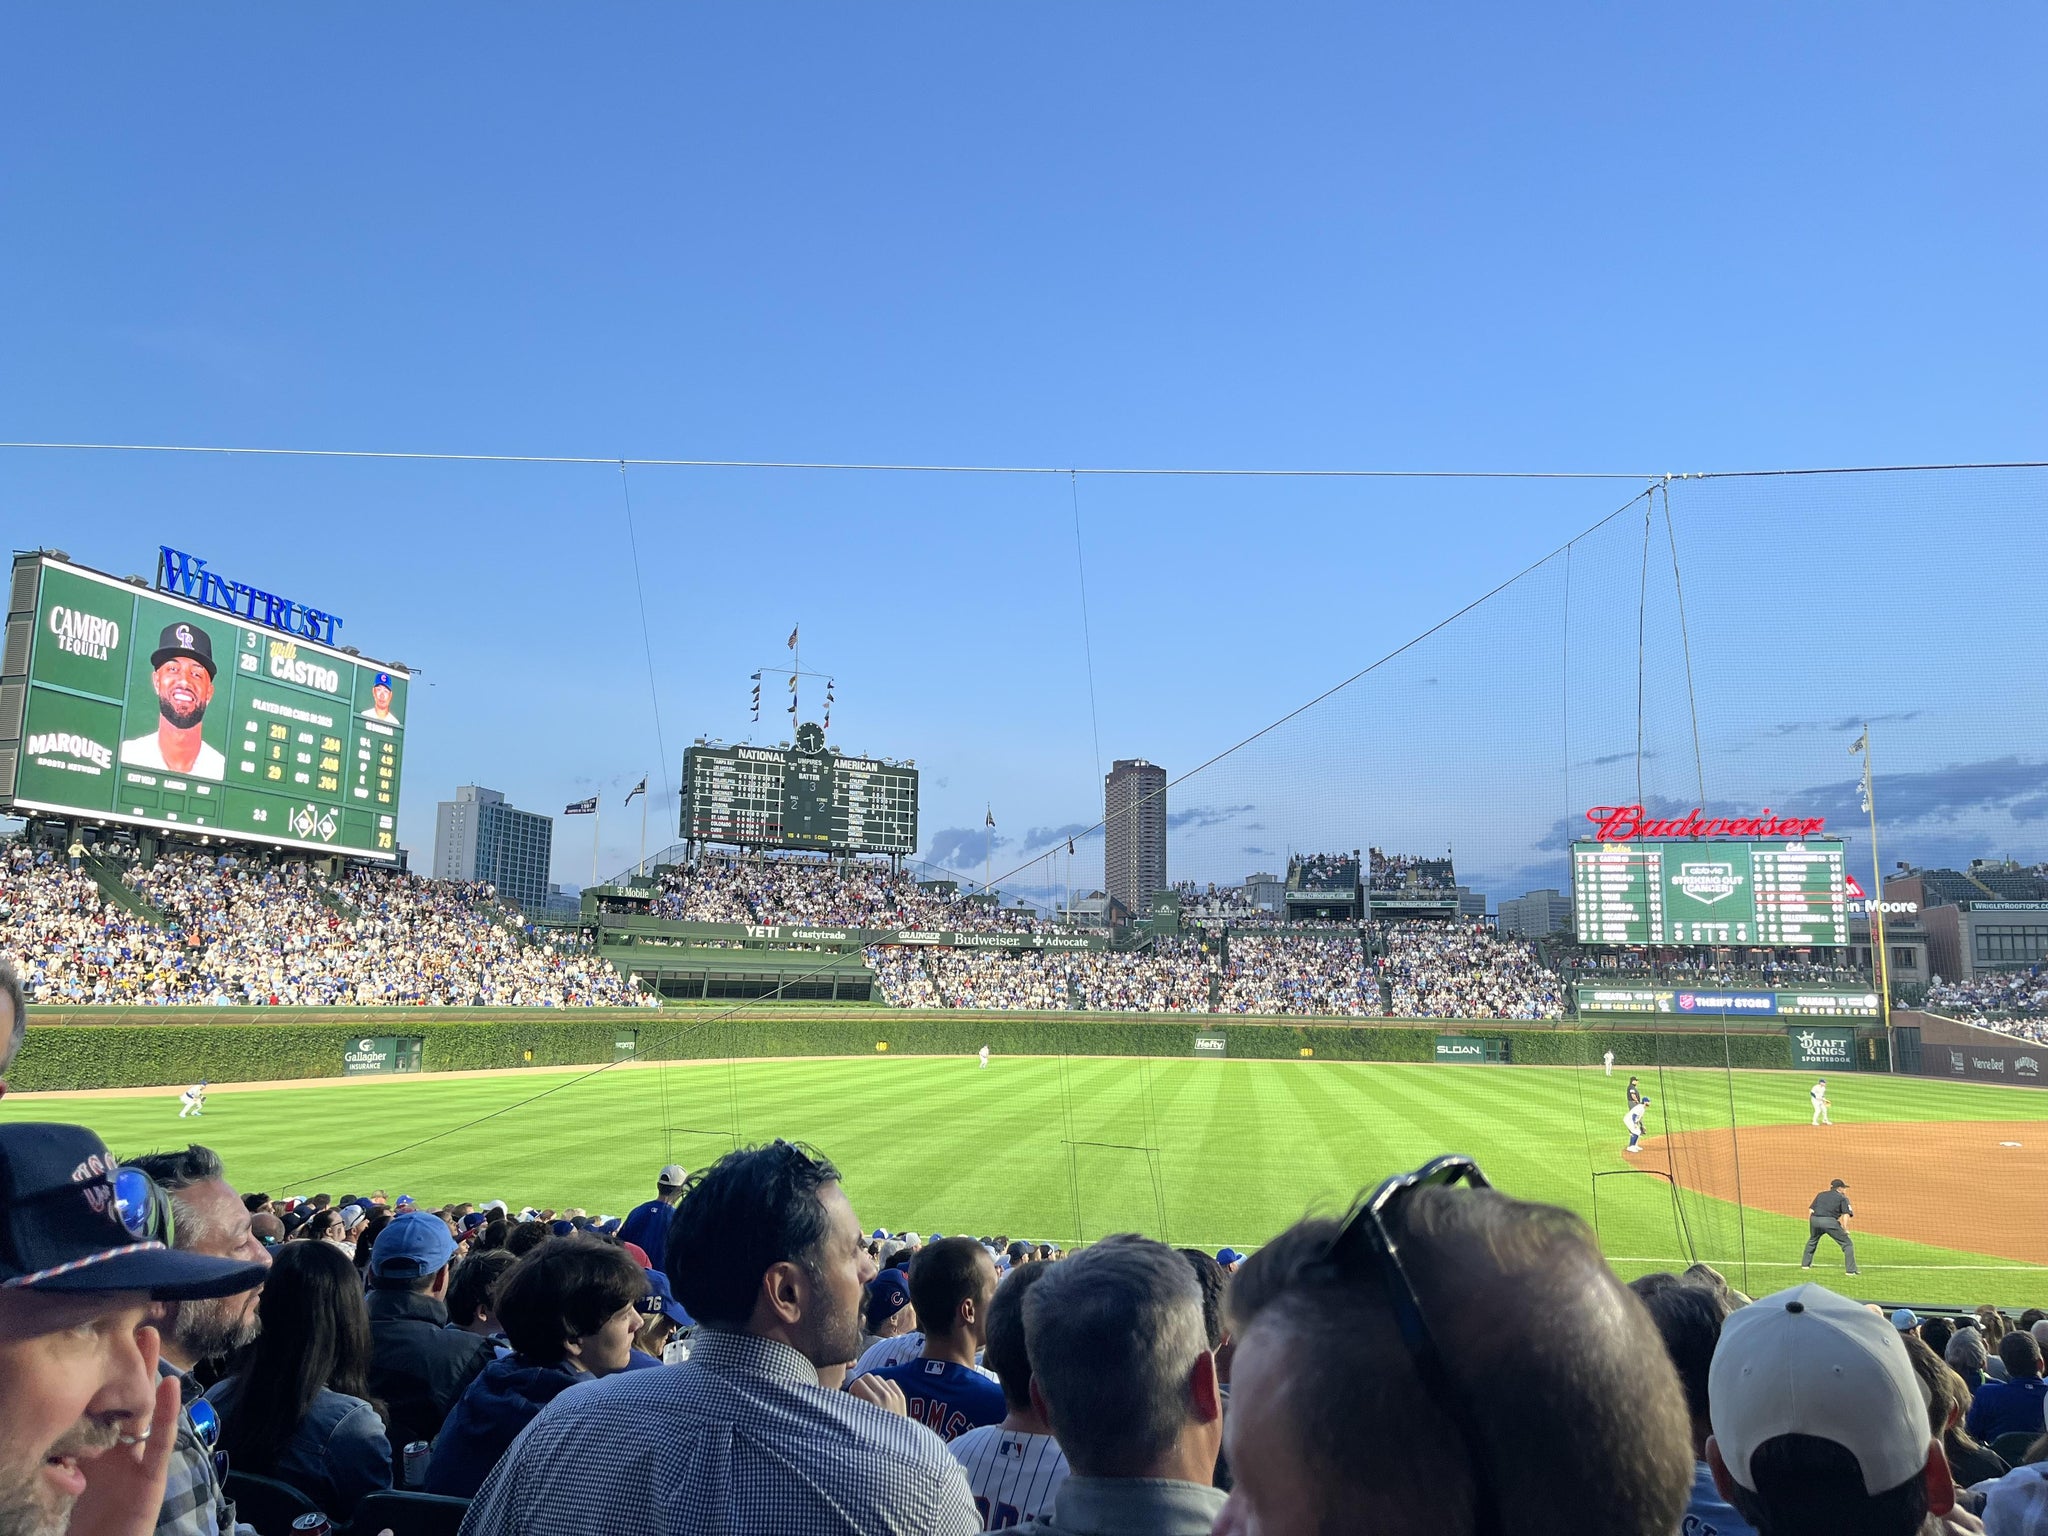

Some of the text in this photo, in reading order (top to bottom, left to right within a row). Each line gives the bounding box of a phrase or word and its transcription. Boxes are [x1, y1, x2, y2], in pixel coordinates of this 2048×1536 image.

[159, 545, 343, 646] WINTRUST
[50, 605, 119, 650] CAMBIO
[247, 632, 256, 648] 3
[58, 634, 107, 661] TEQUILA
[271, 656, 339, 693] CASTRO
[27, 732, 113, 769] MARQUEE
[738, 749, 786, 763] NATIONAL
[797, 757, 822, 766] UMPIRES
[833, 758, 878, 772] AMERICAN
[798, 773, 820, 781] BATTER
[809, 782, 816, 791] 3
[791, 800, 798, 810] 2
[818, 802, 825, 812] 2
[1586, 804, 1826, 841] Budweiser
[378, 832, 392, 849] 73
[1672, 876, 1744, 885] STRIKING OUT
[624, 887, 649, 898] Mobile
[1865, 900, 1917, 912] Moore
[746, 926, 780, 938] YETI
[799, 928, 846, 940] tastytrade
[898, 932, 940, 940] GRAINGER
[1045, 937, 1089, 947] Advocate
[1695, 998, 1770, 1008] THRIFT STORE
[1197, 1040, 1222, 1049] Hefty
[1800, 1039, 1846, 1049] DRAFT
[345, 1051, 387, 1062] Gallagher
[1807, 1048, 1846, 1056] KINGS
[891, 1291, 903, 1306] C
